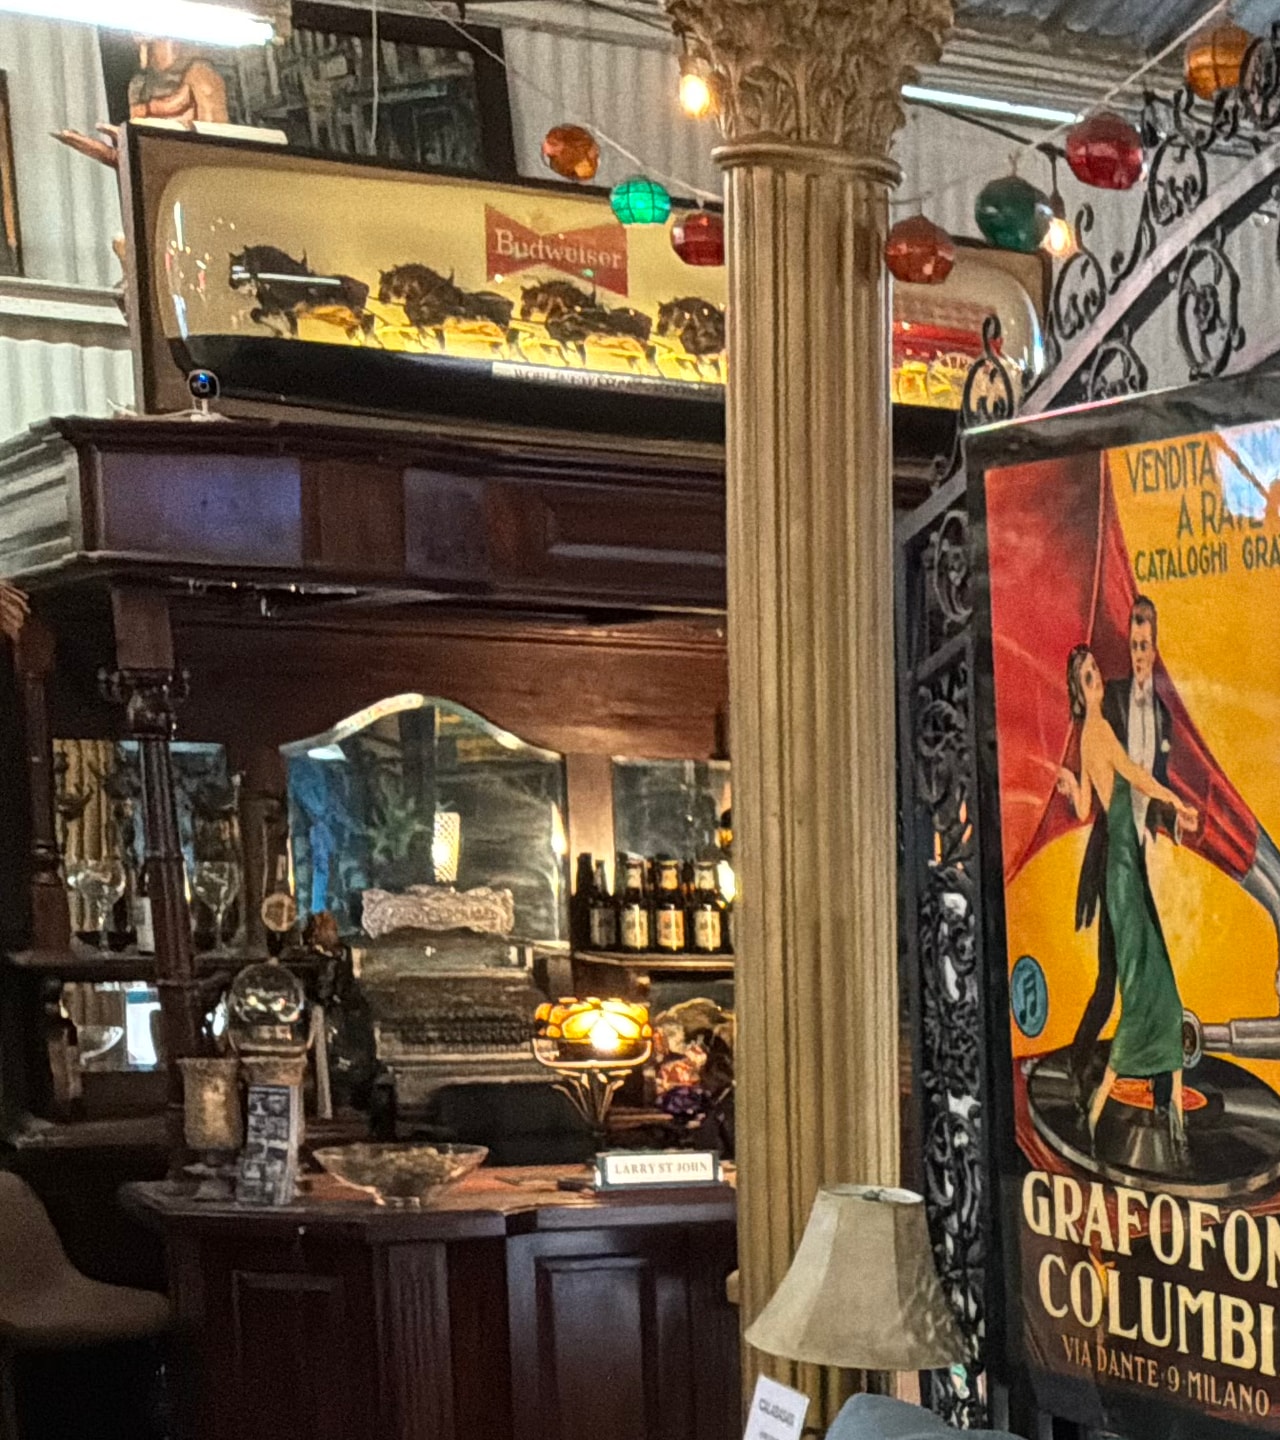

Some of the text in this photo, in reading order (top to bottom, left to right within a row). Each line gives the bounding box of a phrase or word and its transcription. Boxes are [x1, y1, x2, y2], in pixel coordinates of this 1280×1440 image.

[494, 228, 622, 269] Budweiser
[1124, 441, 1218, 493] VENDITA
[1177, 494, 1194, 539] A
[1134, 542, 1228, 583] CATALOGHI
[615, 1161, 708, 1175] LARRY ST JOHN
[1062, 1334, 1092, 1370] VIA
[1096, 1344, 1159, 1388] DANTE
[1188, 1370, 1270, 1417] MILANO
